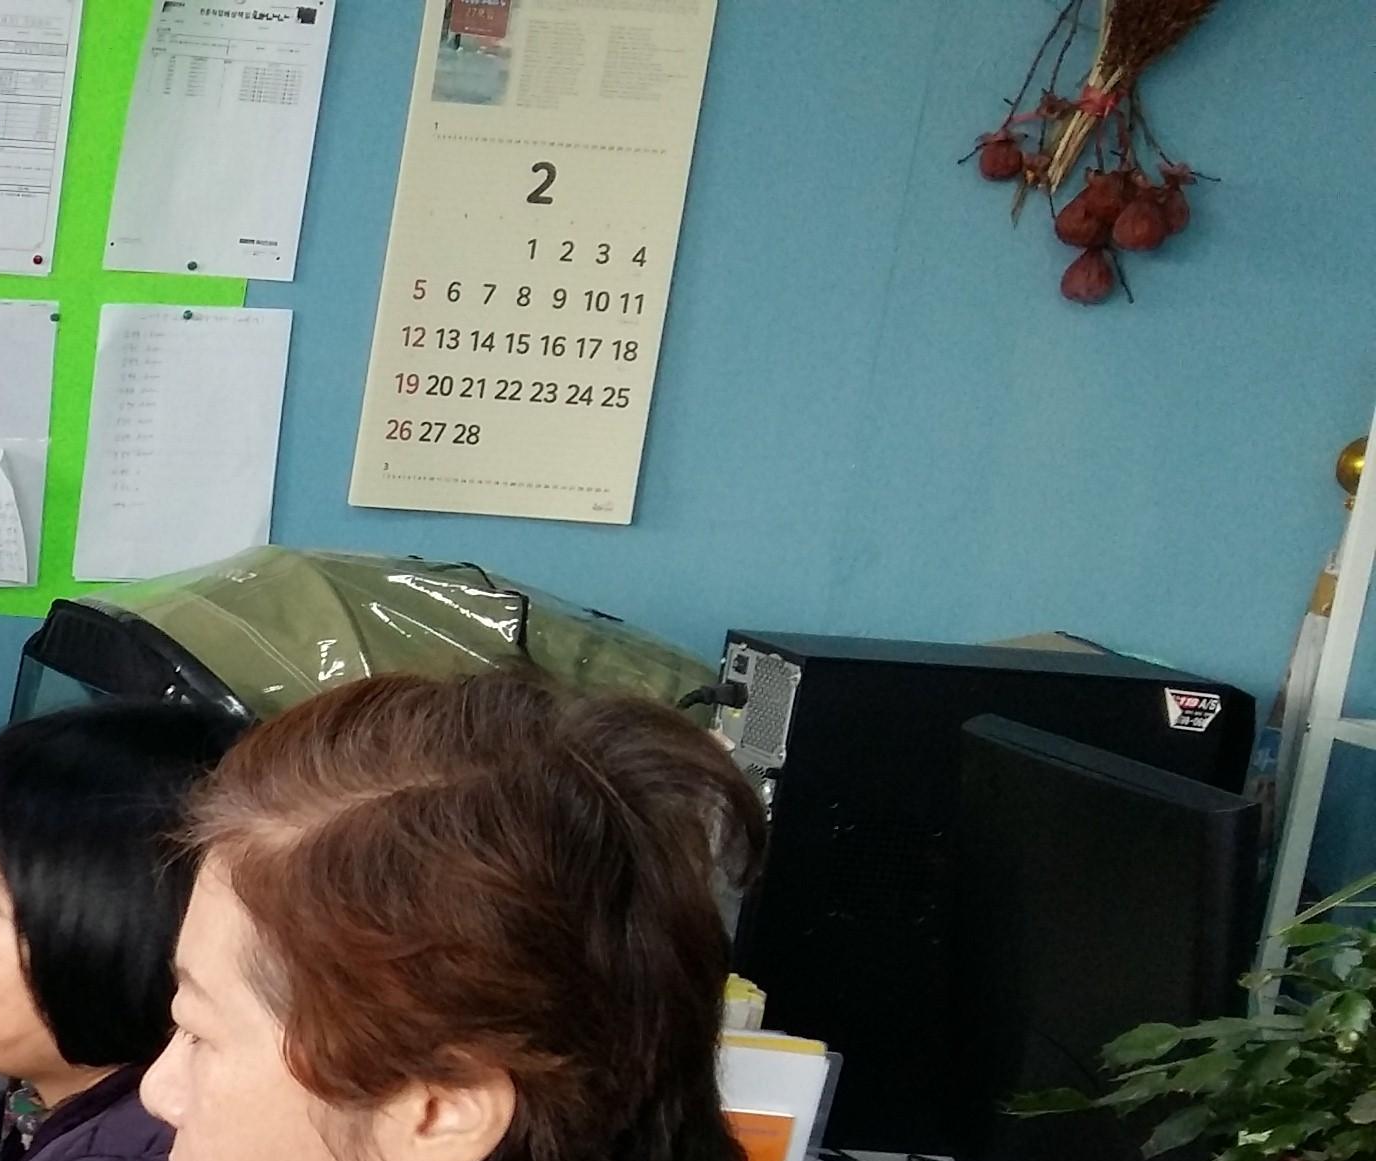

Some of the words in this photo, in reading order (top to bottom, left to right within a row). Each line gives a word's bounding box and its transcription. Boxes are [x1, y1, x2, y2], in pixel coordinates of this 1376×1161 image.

[526, 162, 556, 205] 2
[527, 238, 537, 260] 1
[559, 240, 574, 262] 2
[595, 243, 610, 265] 3
[632, 246, 647, 267] 4
[412, 279, 427, 300] 5
[447, 281, 462, 303] 6
[483, 283, 497, 305] 7
[516, 286, 532, 307] 8
[552, 288, 567, 310] 9
[584, 290, 610, 312] 10
[620, 292, 644, 315] 11
[402, 326, 426, 348] 12
[436, 328, 461, 350] 13
[470, 330, 495, 353] 14
[505, 333, 531, 355] 15
[540, 335, 567, 357] 16
[576, 337, 603, 359] 17
[612, 340, 638, 362] 18
[395, 373, 420, 395] 19
[425, 374, 454, 397] 20
[459, 377, 486, 399] 21
[494, 379, 523, 401] 22
[529, 381, 558, 404] 23
[565, 384, 593, 406] 24
[600, 386, 631, 409] 25
[385, 419, 413, 441] 26
[418, 421, 447, 443] 27
[452, 423, 481, 445] 28
